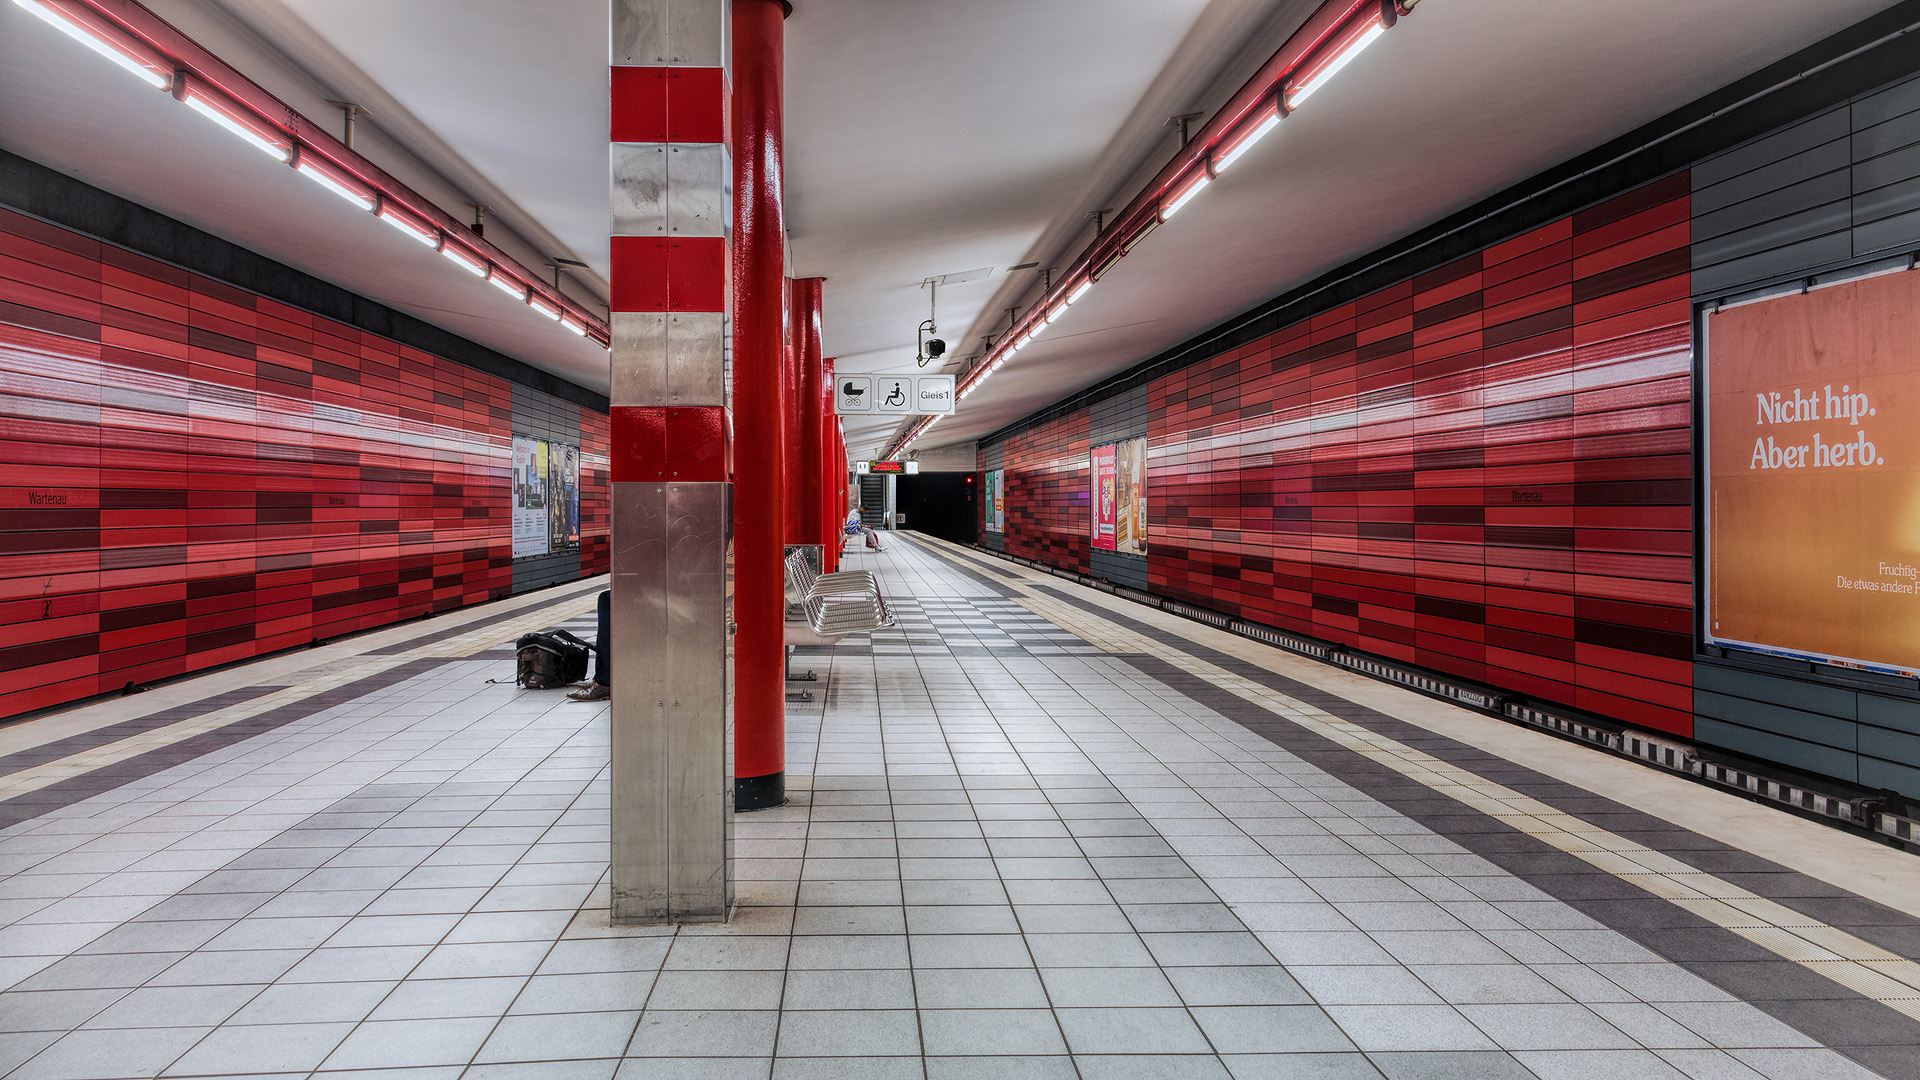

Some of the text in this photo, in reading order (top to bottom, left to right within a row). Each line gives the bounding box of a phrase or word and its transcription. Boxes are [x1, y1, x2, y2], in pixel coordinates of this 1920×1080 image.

[1756, 384, 1876, 426] Nicht hip.
[1750, 430, 1884, 470] Aber herb.
[28, 491, 67, 505] Wartenau
[1511, 489, 1543, 503] Wartenau
[1879, 561, 1920, 580] Fruchtig-
[1837, 575, 1853, 589] Die
[1853, 578, 1879, 591] etwas
[1880, 579, 1913, 594] andere
